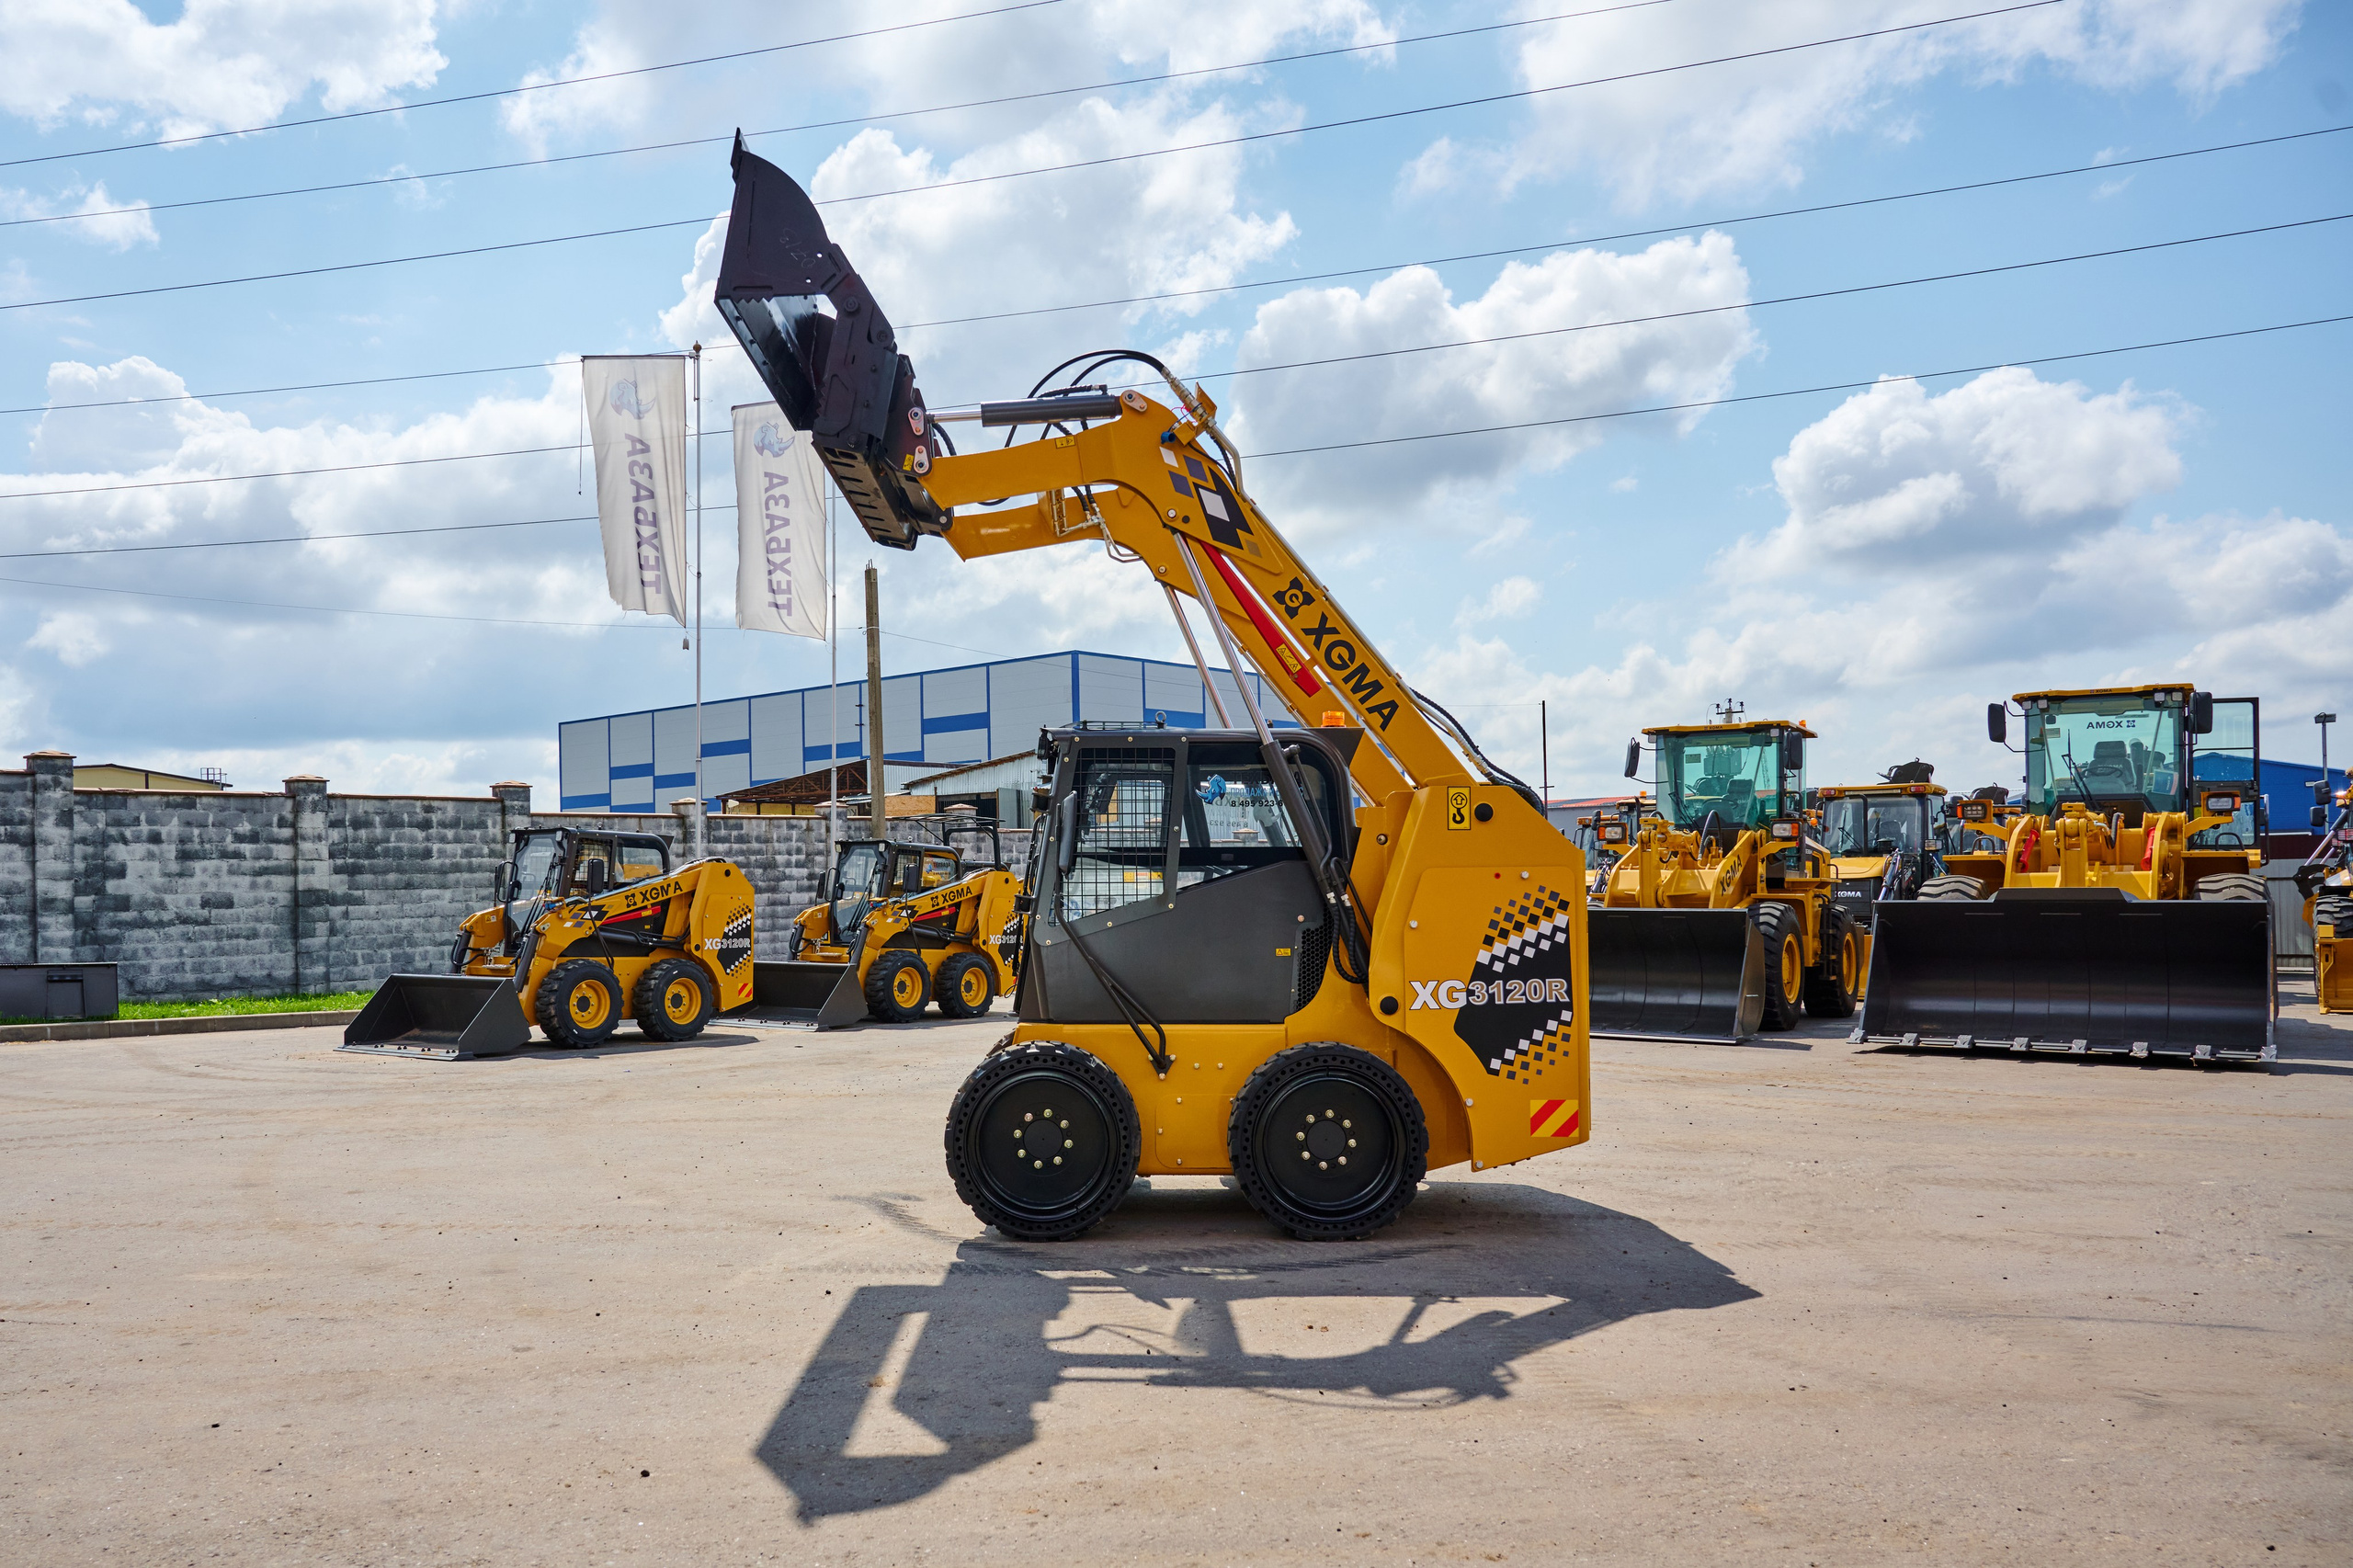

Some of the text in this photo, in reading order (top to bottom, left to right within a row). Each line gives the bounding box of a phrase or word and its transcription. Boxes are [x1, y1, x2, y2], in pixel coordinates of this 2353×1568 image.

[1301, 611, 1400, 733] XGMA
[1720, 854, 1743, 897] XGMA
[640, 881, 683, 904] XGMA
[941, 886, 972, 904] XGMA
[704, 937, 751, 950] XG3120R
[1409, 978, 1571, 1011] XG3120R
